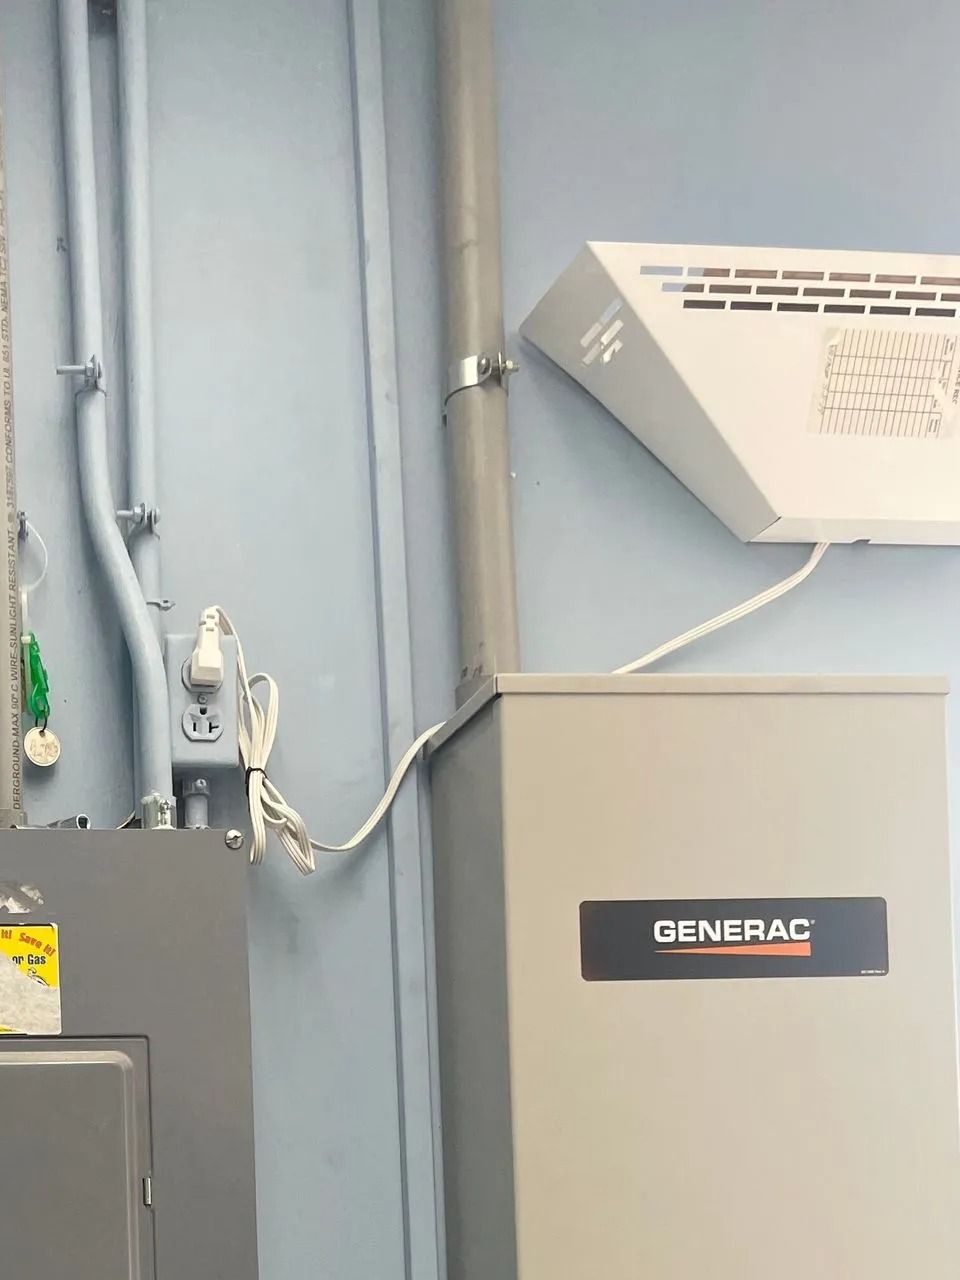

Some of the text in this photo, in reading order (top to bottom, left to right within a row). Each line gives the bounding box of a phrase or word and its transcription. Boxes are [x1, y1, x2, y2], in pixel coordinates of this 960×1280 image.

[0, 281, 8, 312] NEMA
[3, 381, 11, 396] TO
[4, 400, 12, 464] CONFORMS
[8, 530, 18, 591] RESISTANT
[653, 918, 810, 943] GENERAC
[28, 954, 46, 965] Gas
